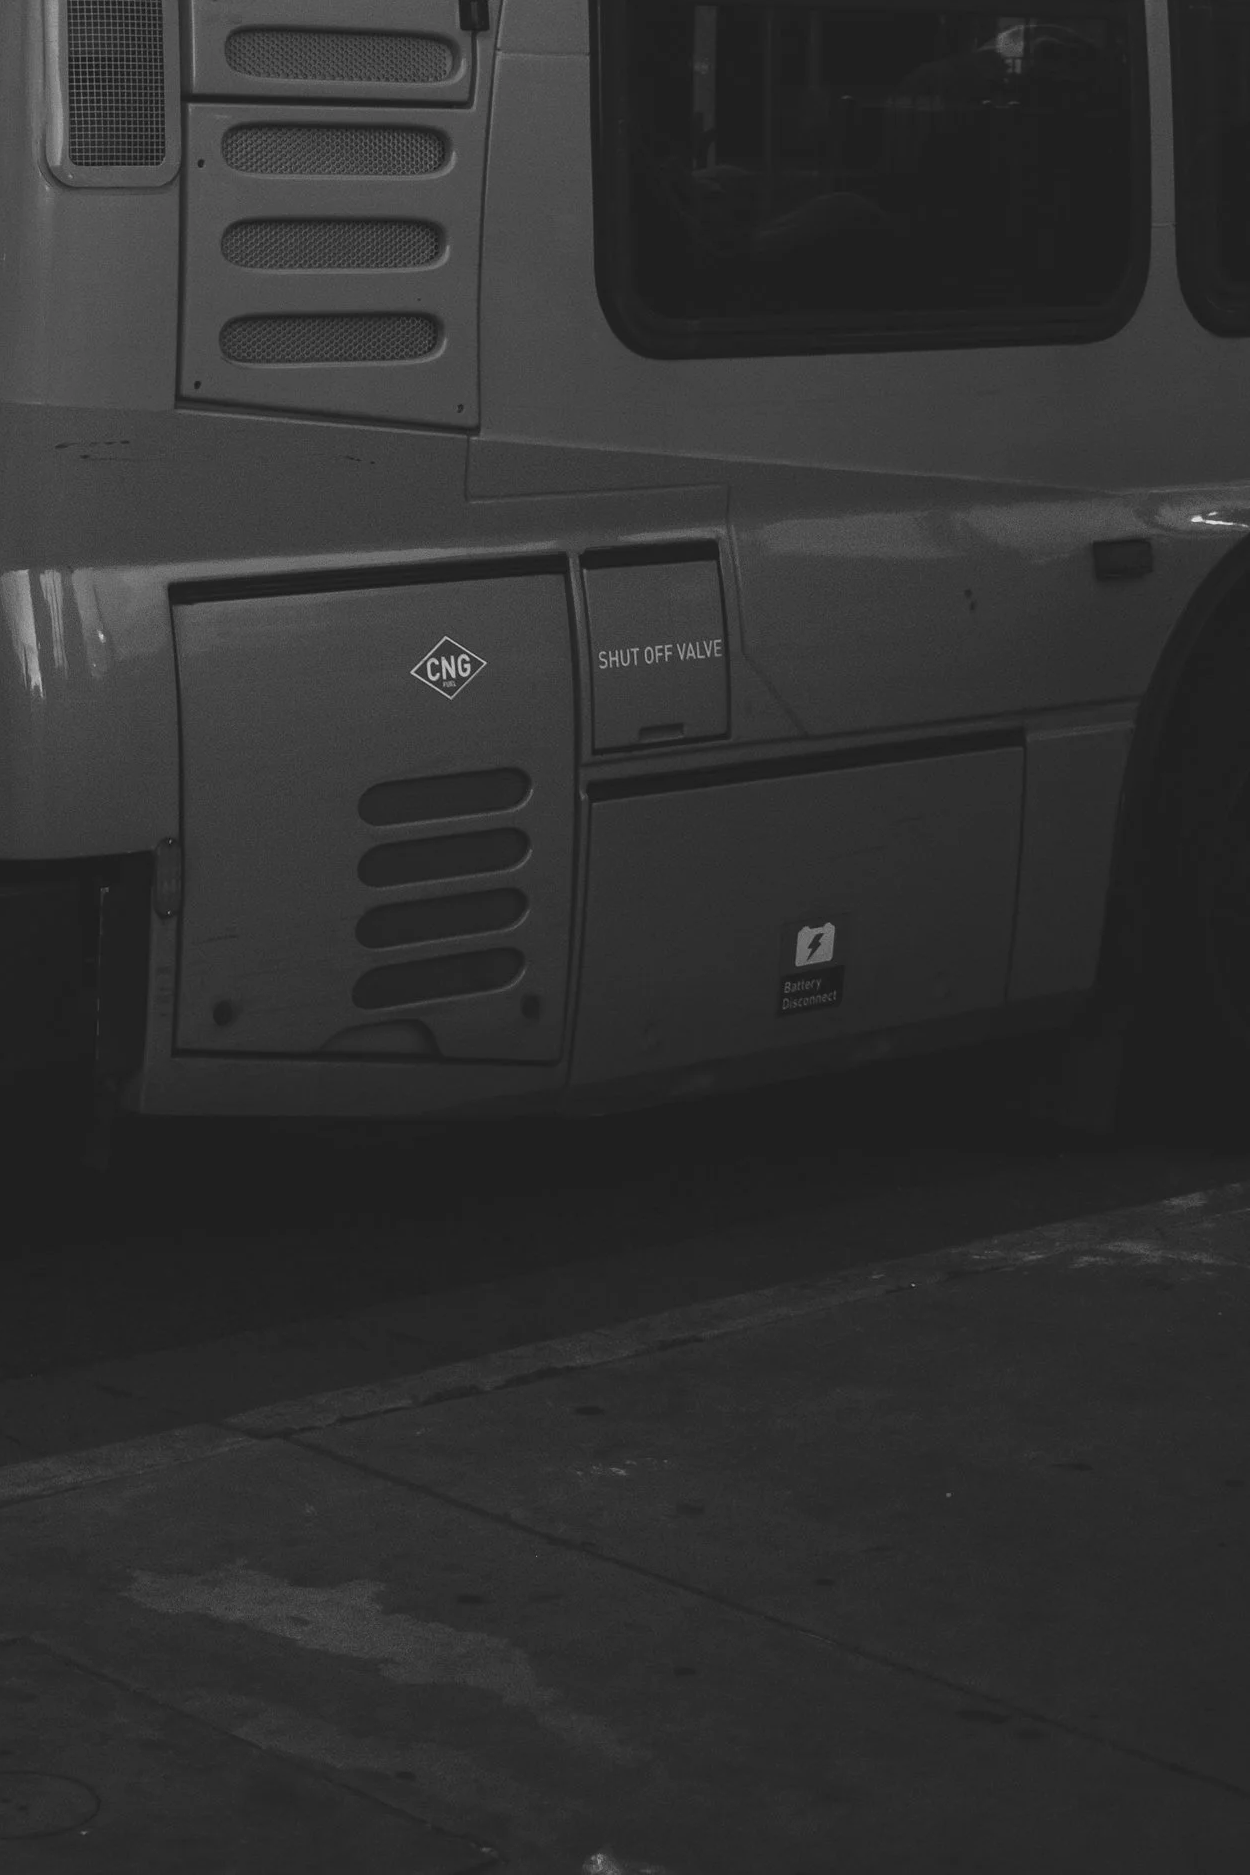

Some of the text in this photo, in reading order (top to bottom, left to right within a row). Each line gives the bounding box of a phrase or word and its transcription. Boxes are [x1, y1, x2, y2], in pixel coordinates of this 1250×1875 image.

[598, 639, 723, 670] SHUT OFF VALVE
[426, 653, 472, 682] CNG
[783, 977, 822, 994] Battery
[781, 989, 838, 1011] Disconnect
